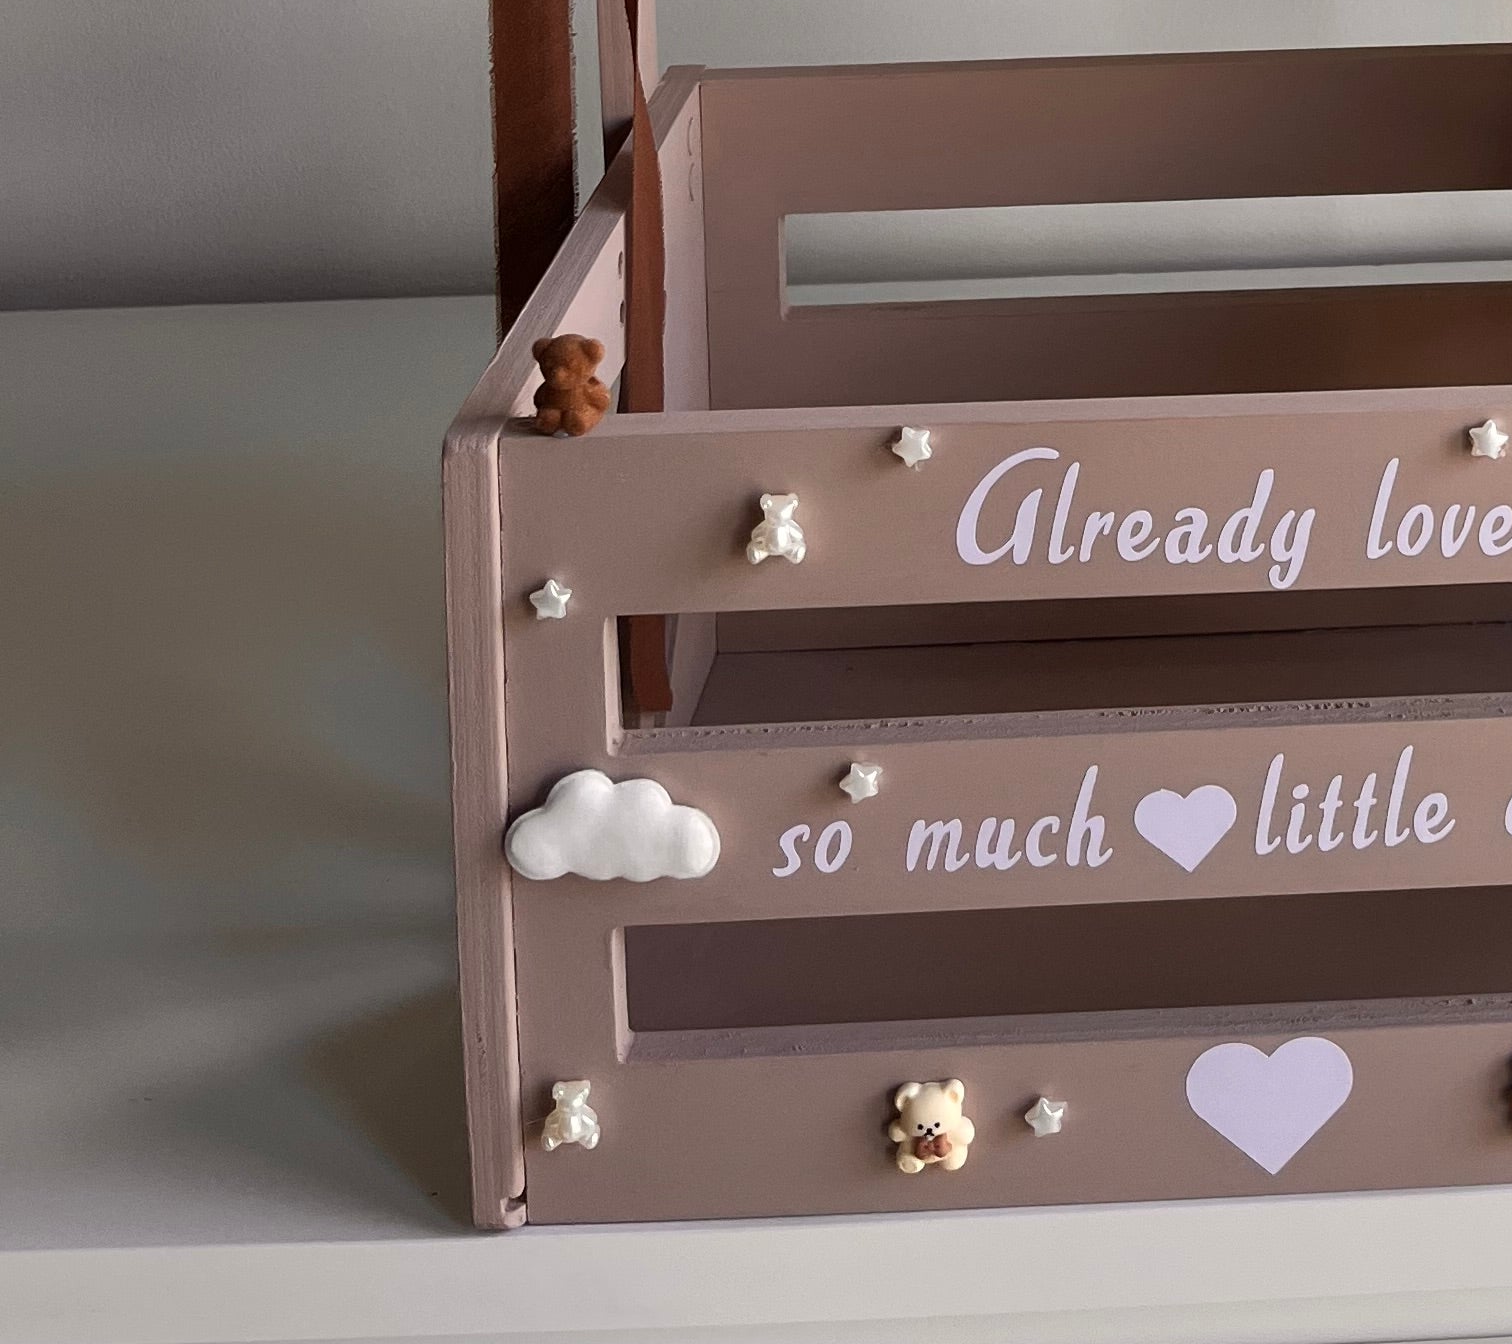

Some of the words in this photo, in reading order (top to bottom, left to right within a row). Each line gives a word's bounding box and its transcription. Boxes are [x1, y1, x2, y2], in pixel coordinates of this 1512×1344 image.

[956, 447, 1316, 589] Already
[772, 820, 853, 877] so
[906, 765, 1113, 872] much
[1255, 744, 1456, 855] little
